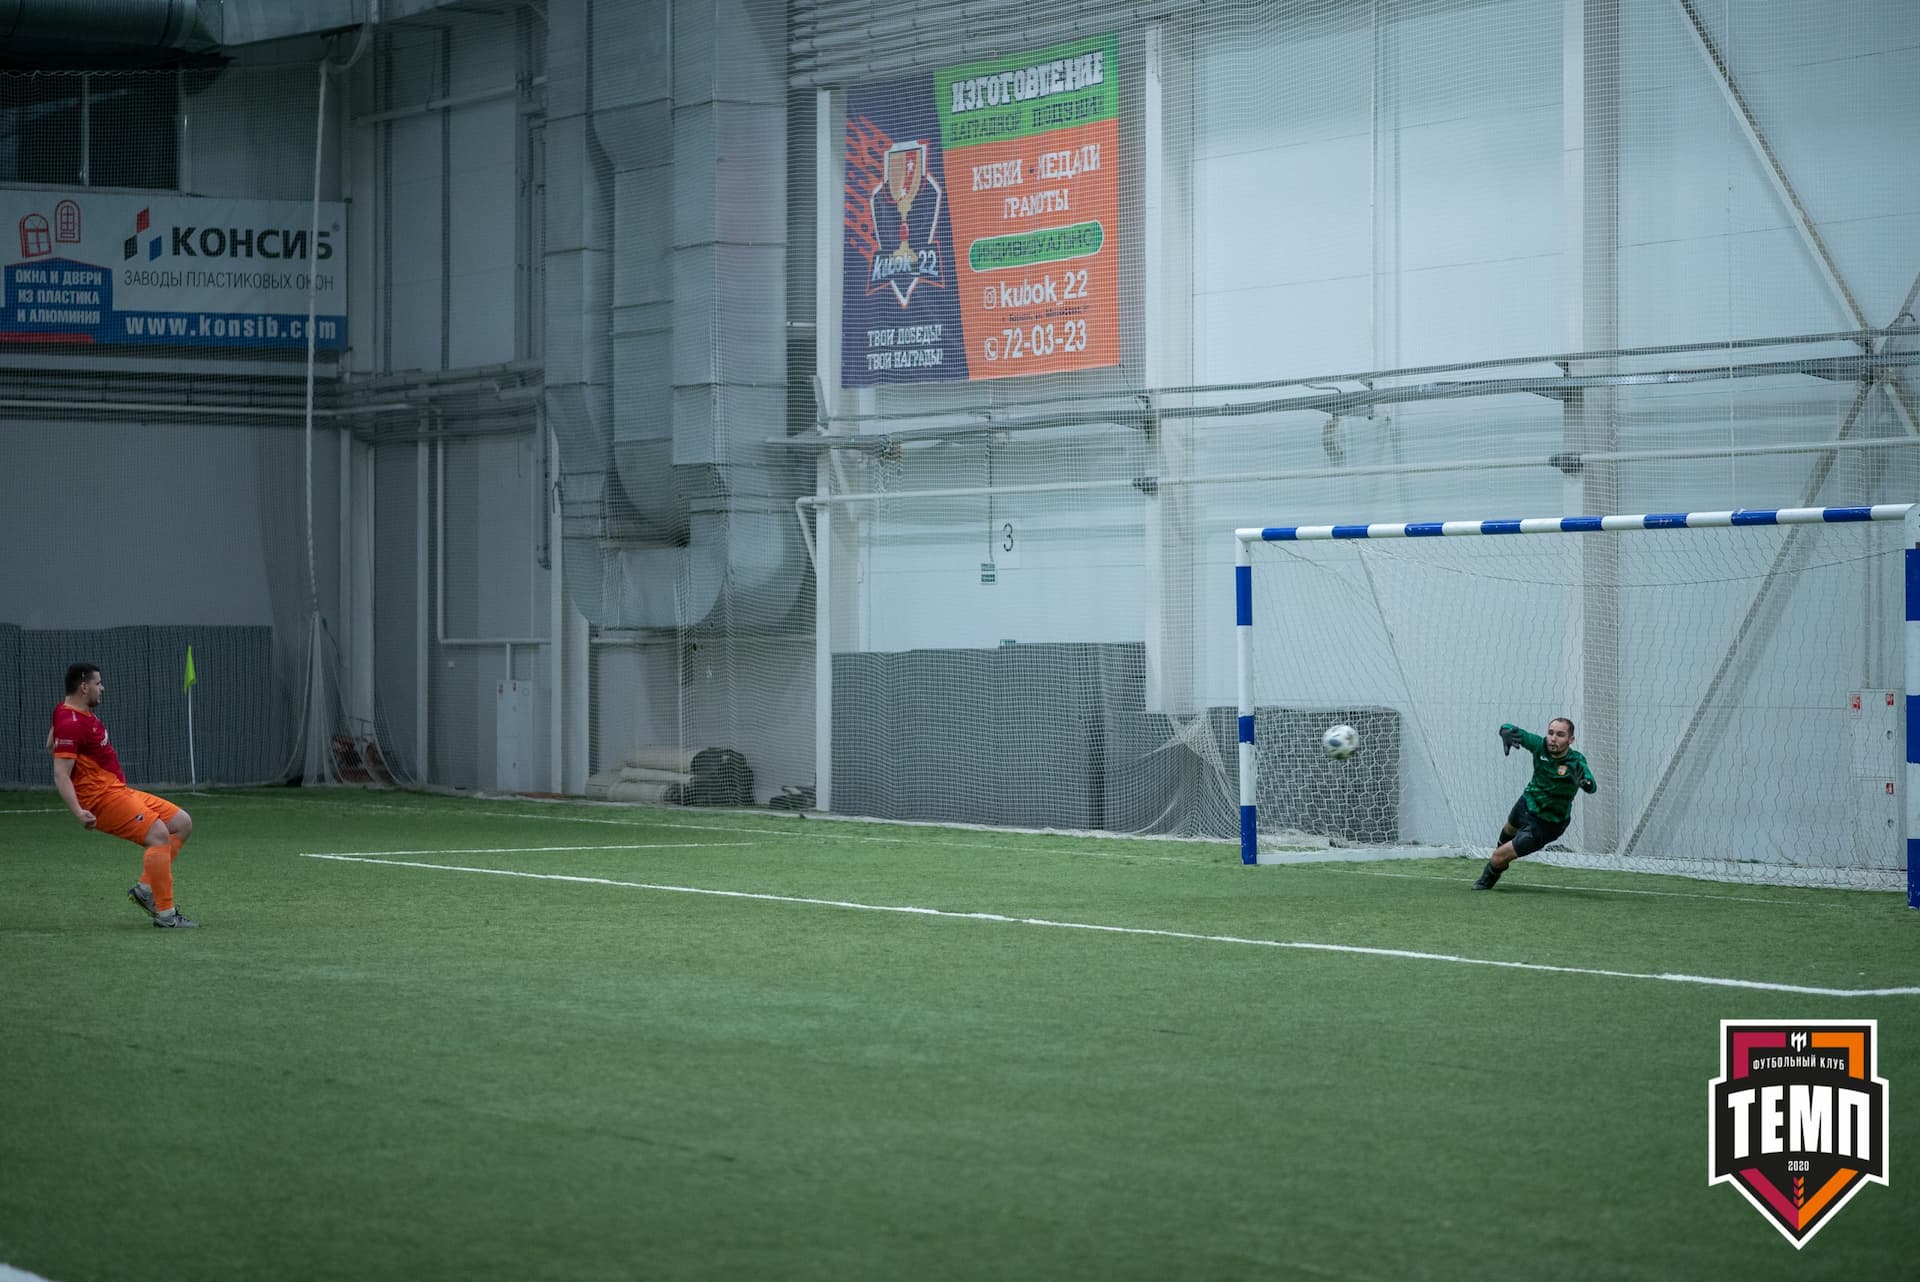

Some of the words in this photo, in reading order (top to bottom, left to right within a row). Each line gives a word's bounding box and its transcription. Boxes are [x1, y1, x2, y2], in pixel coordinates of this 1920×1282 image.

[952, 52, 1104, 114] ИЗГОТОВЛЕНИЕ
[972, 159, 1024, 193] КУБКИ
[1003, 188, 1070, 219] ГРАМОТЫ
[172, 226, 333, 260] КОНСИБ
[16, 269, 47, 284] ОКНА
[50, 271, 58, 284] И
[62, 271, 102, 286] ДВЕРИ
[124, 269, 182, 288] ЗАВОДЫ
[186, 271, 292, 290] ПЛАСТИКОВЫХ
[1000, 269, 1088, 309] kubok_22
[18, 289, 34, 303] ИЗ
[38, 290, 100, 304] ПЛАСТИКА
[17, 310, 26, 322] И
[29, 310, 100, 324] АЛЮМИНИЯ
[1002, 318, 1087, 360] 72-03-23
[1003, 522, 1014, 552] 3
